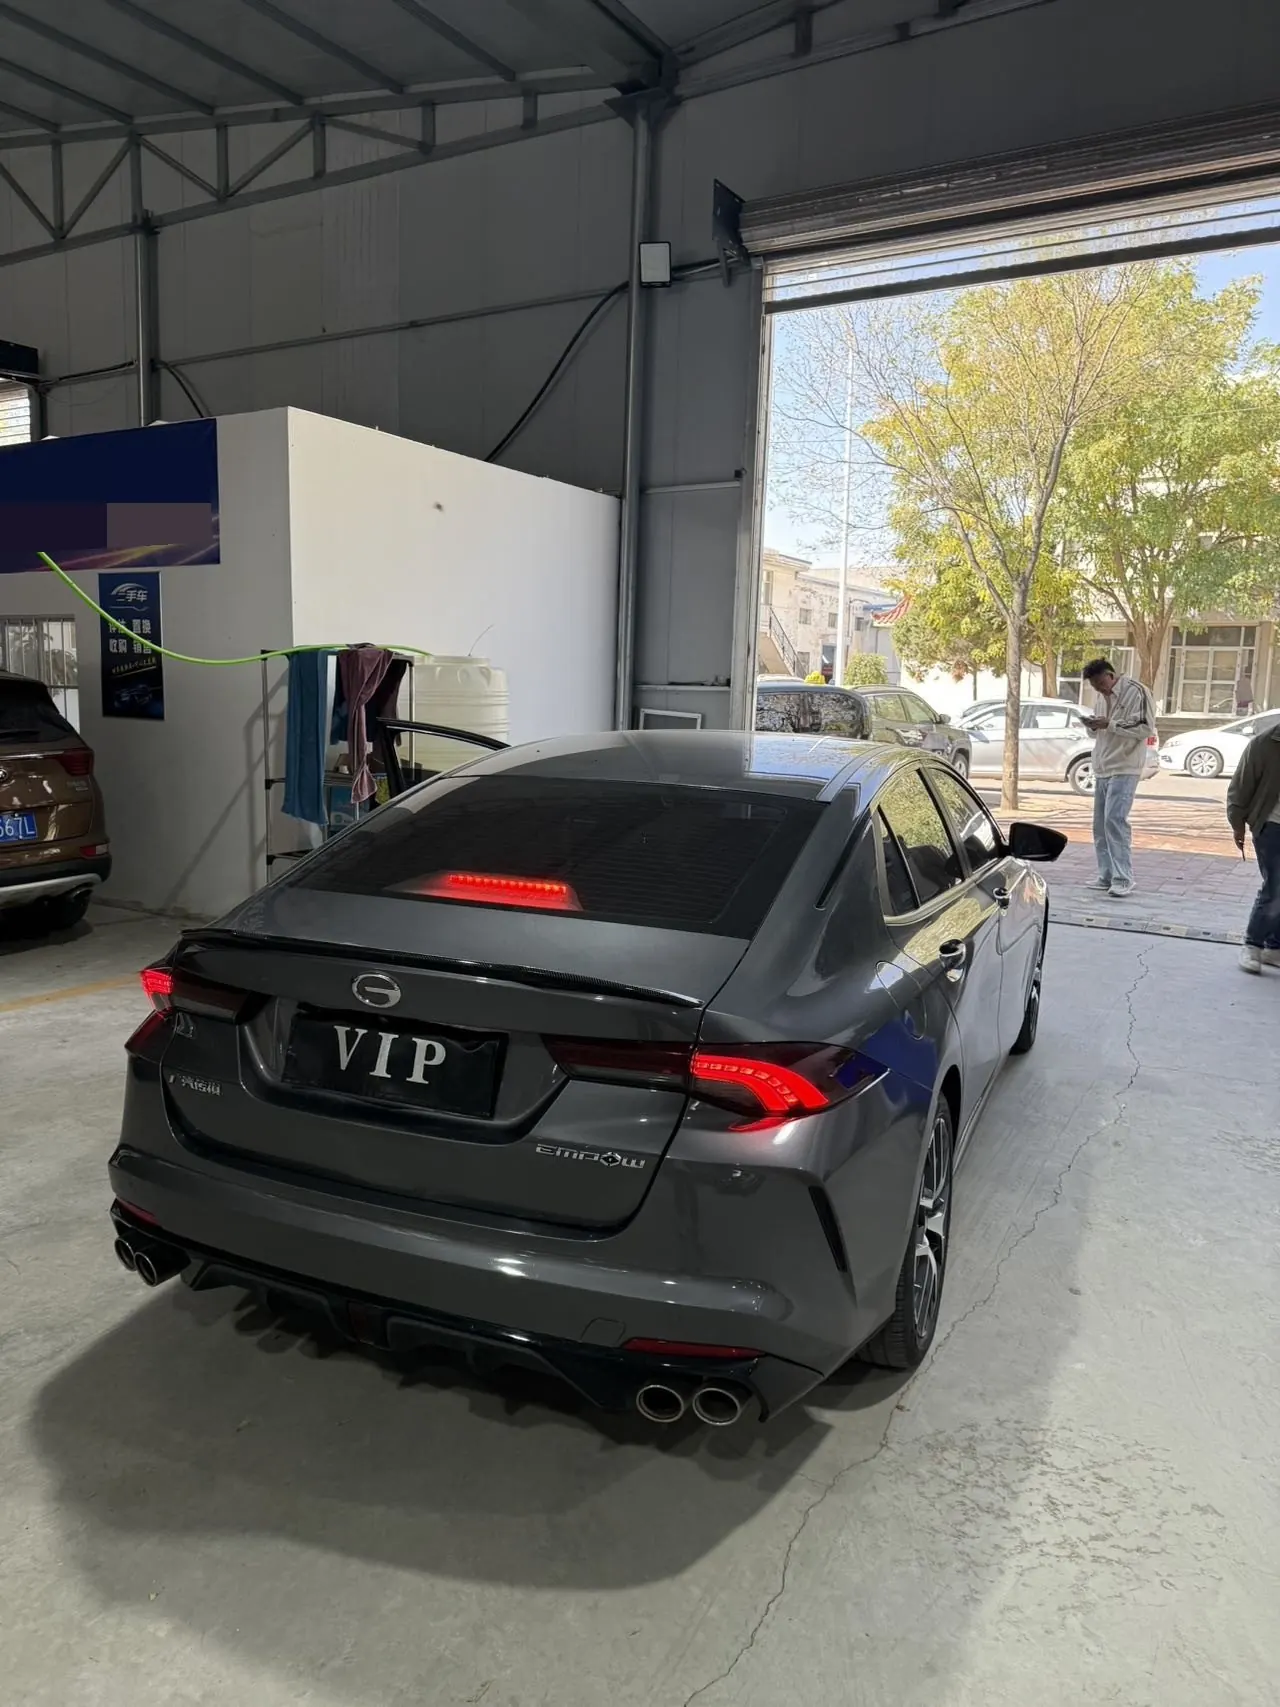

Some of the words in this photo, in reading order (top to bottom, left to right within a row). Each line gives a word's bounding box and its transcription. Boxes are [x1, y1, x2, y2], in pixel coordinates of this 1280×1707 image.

[115, 589, 149, 602] 二手车
[132, 618, 152, 634] 置换
[108, 638, 128, 654] 收购
[333, 1025, 447, 1085] VIP
